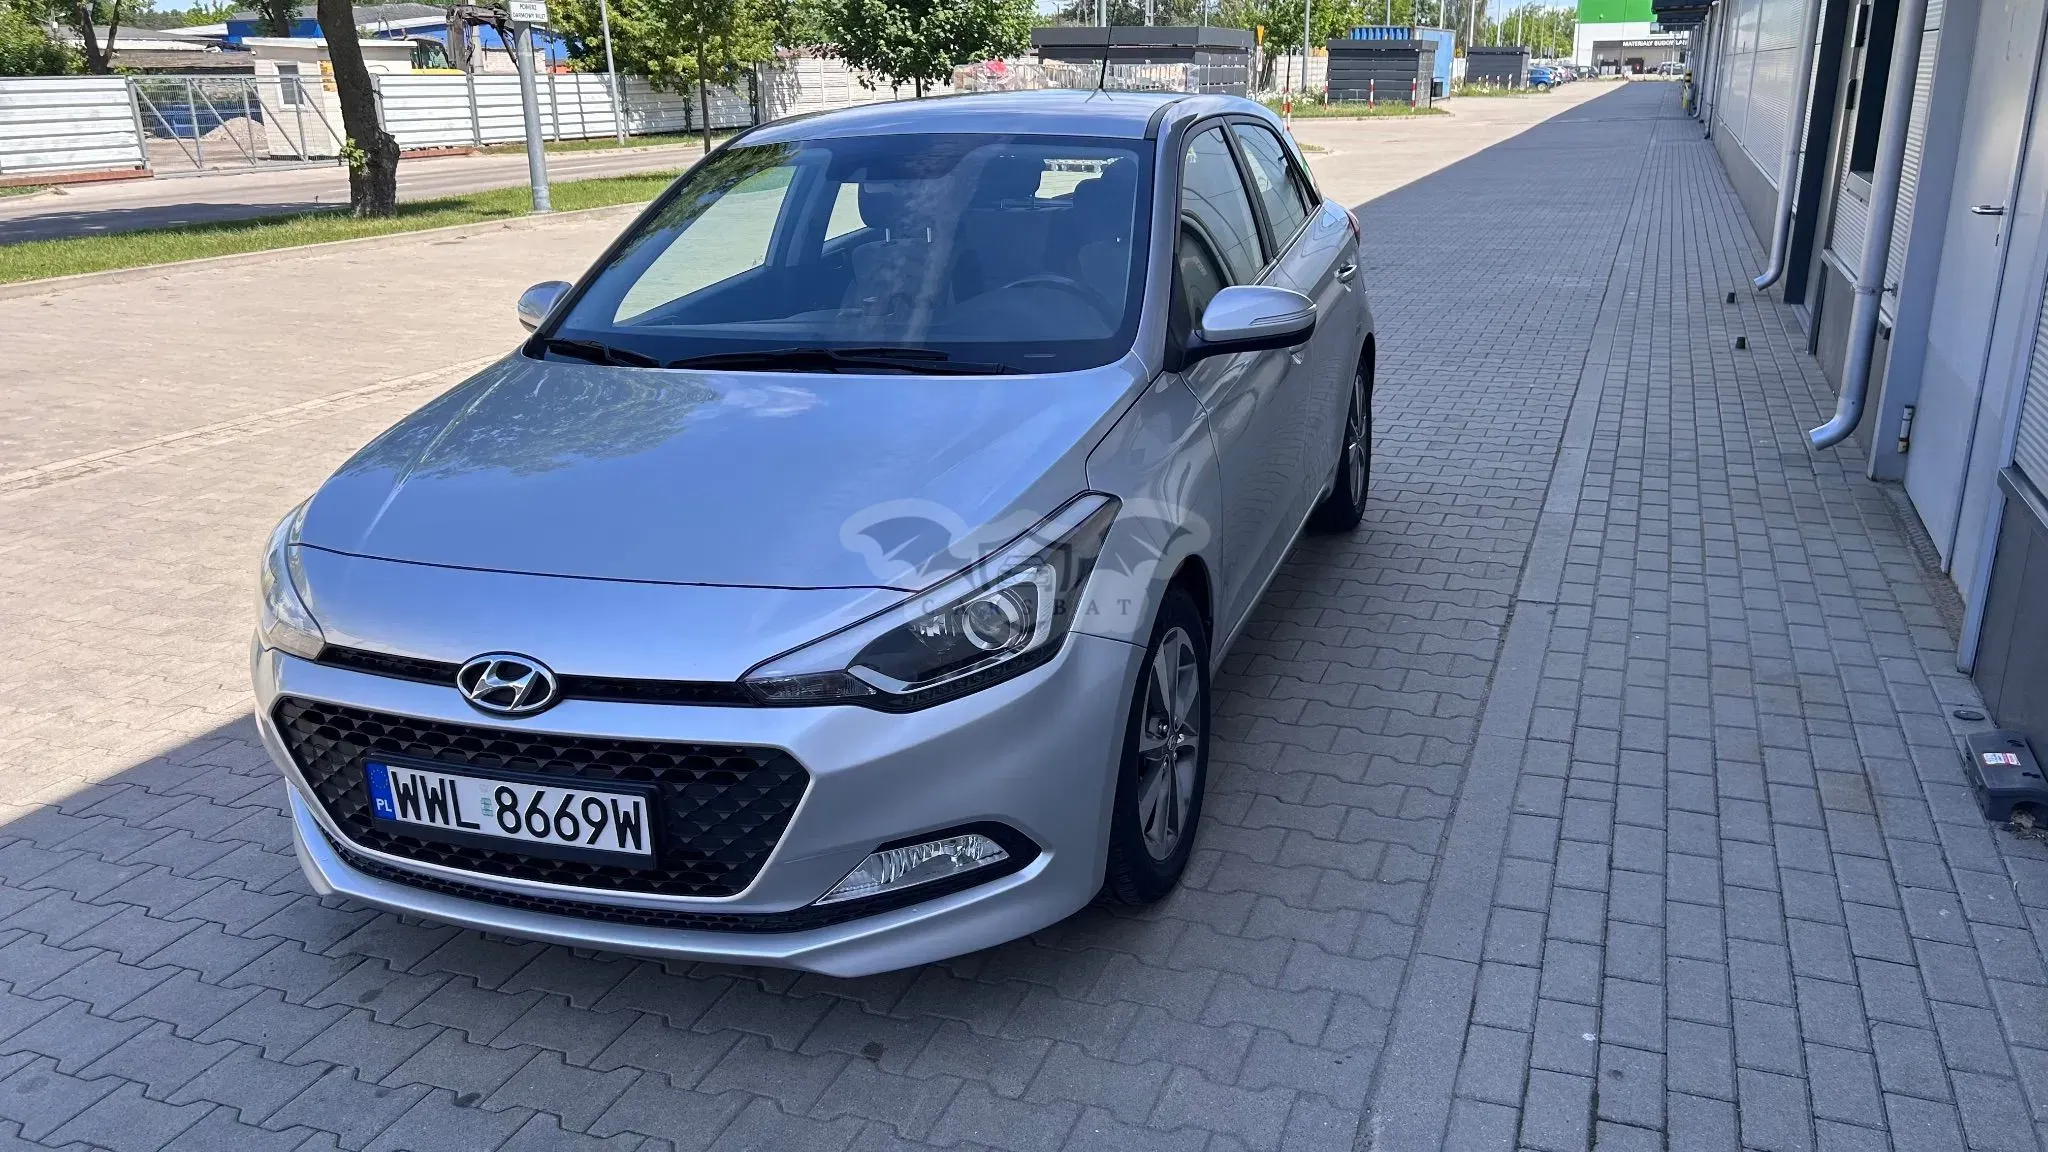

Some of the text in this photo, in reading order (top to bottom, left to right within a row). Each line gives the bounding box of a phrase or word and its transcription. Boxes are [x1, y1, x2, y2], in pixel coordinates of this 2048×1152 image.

[376, 797, 393, 813] PL
[390, 770, 642, 850] WWL 8669W
